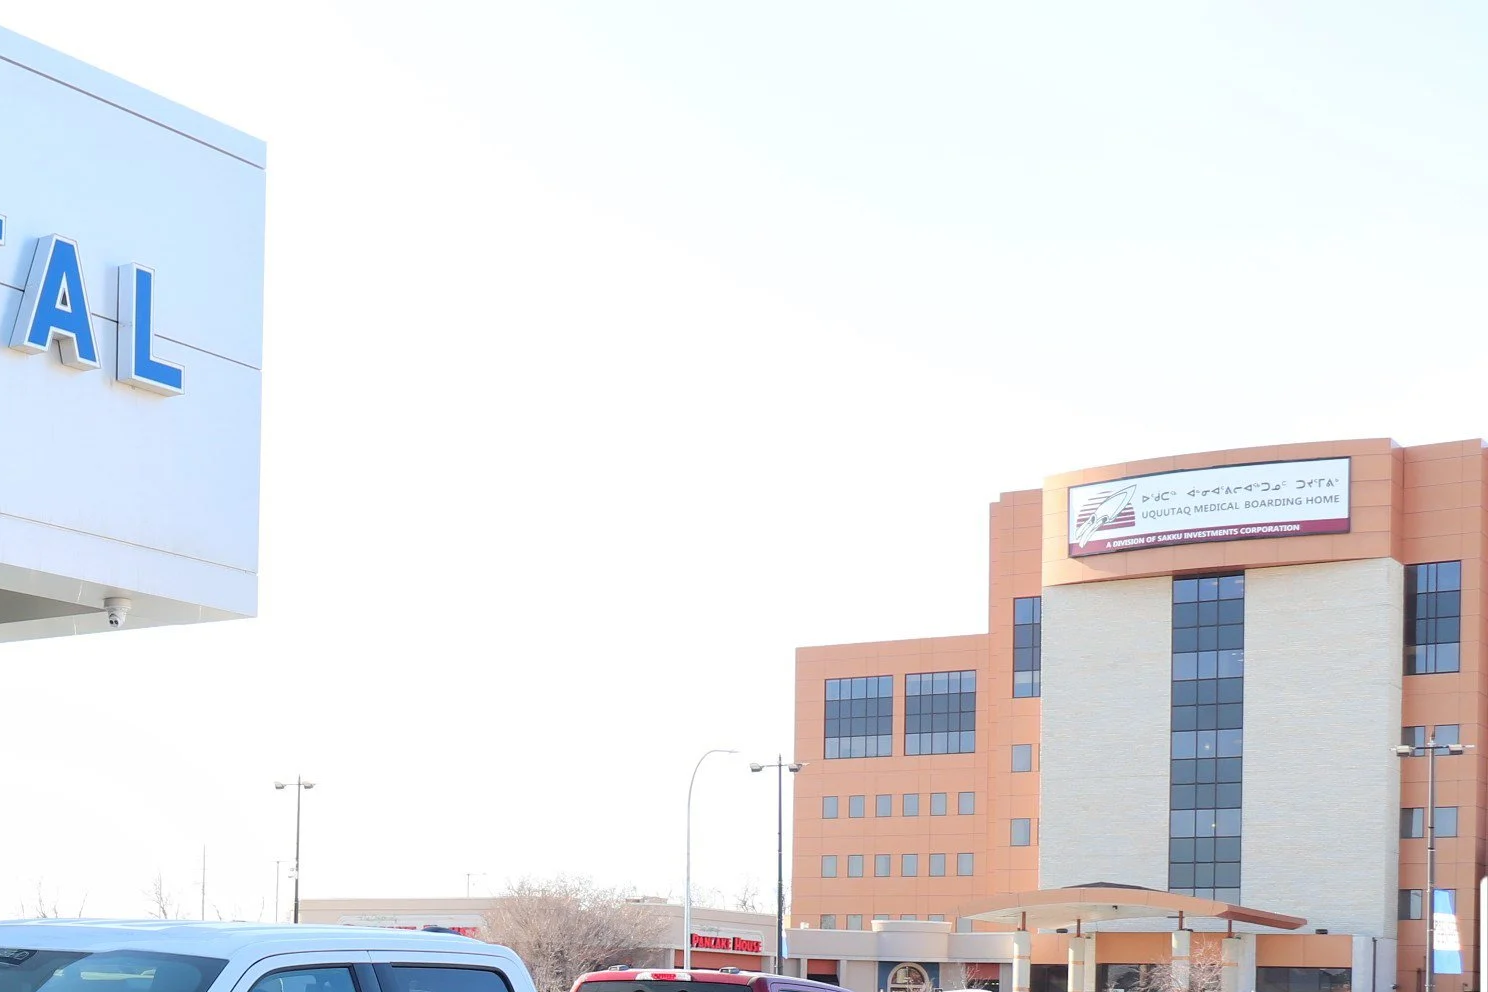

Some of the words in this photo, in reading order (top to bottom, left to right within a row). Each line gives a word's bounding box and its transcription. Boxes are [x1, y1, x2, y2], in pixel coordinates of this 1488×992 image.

[1141, 506, 1192, 520] UQUUTAQ
[1194, 502, 1240, 513] MEDICAL
[1244, 497, 1302, 509] BOARDING
[1306, 494, 1340, 505] HOME
[1106, 541, 1112, 549] A
[1113, 536, 1145, 547] DIVISION
[1146, 535, 1156, 543] OF
[1157, 532, 1183, 542] SAKKU
[1184, 527, 1239, 539] INVESTMENTS
[1240, 524, 1300, 534] CORPORATION
[733, 937, 762, 953] HOUSE
